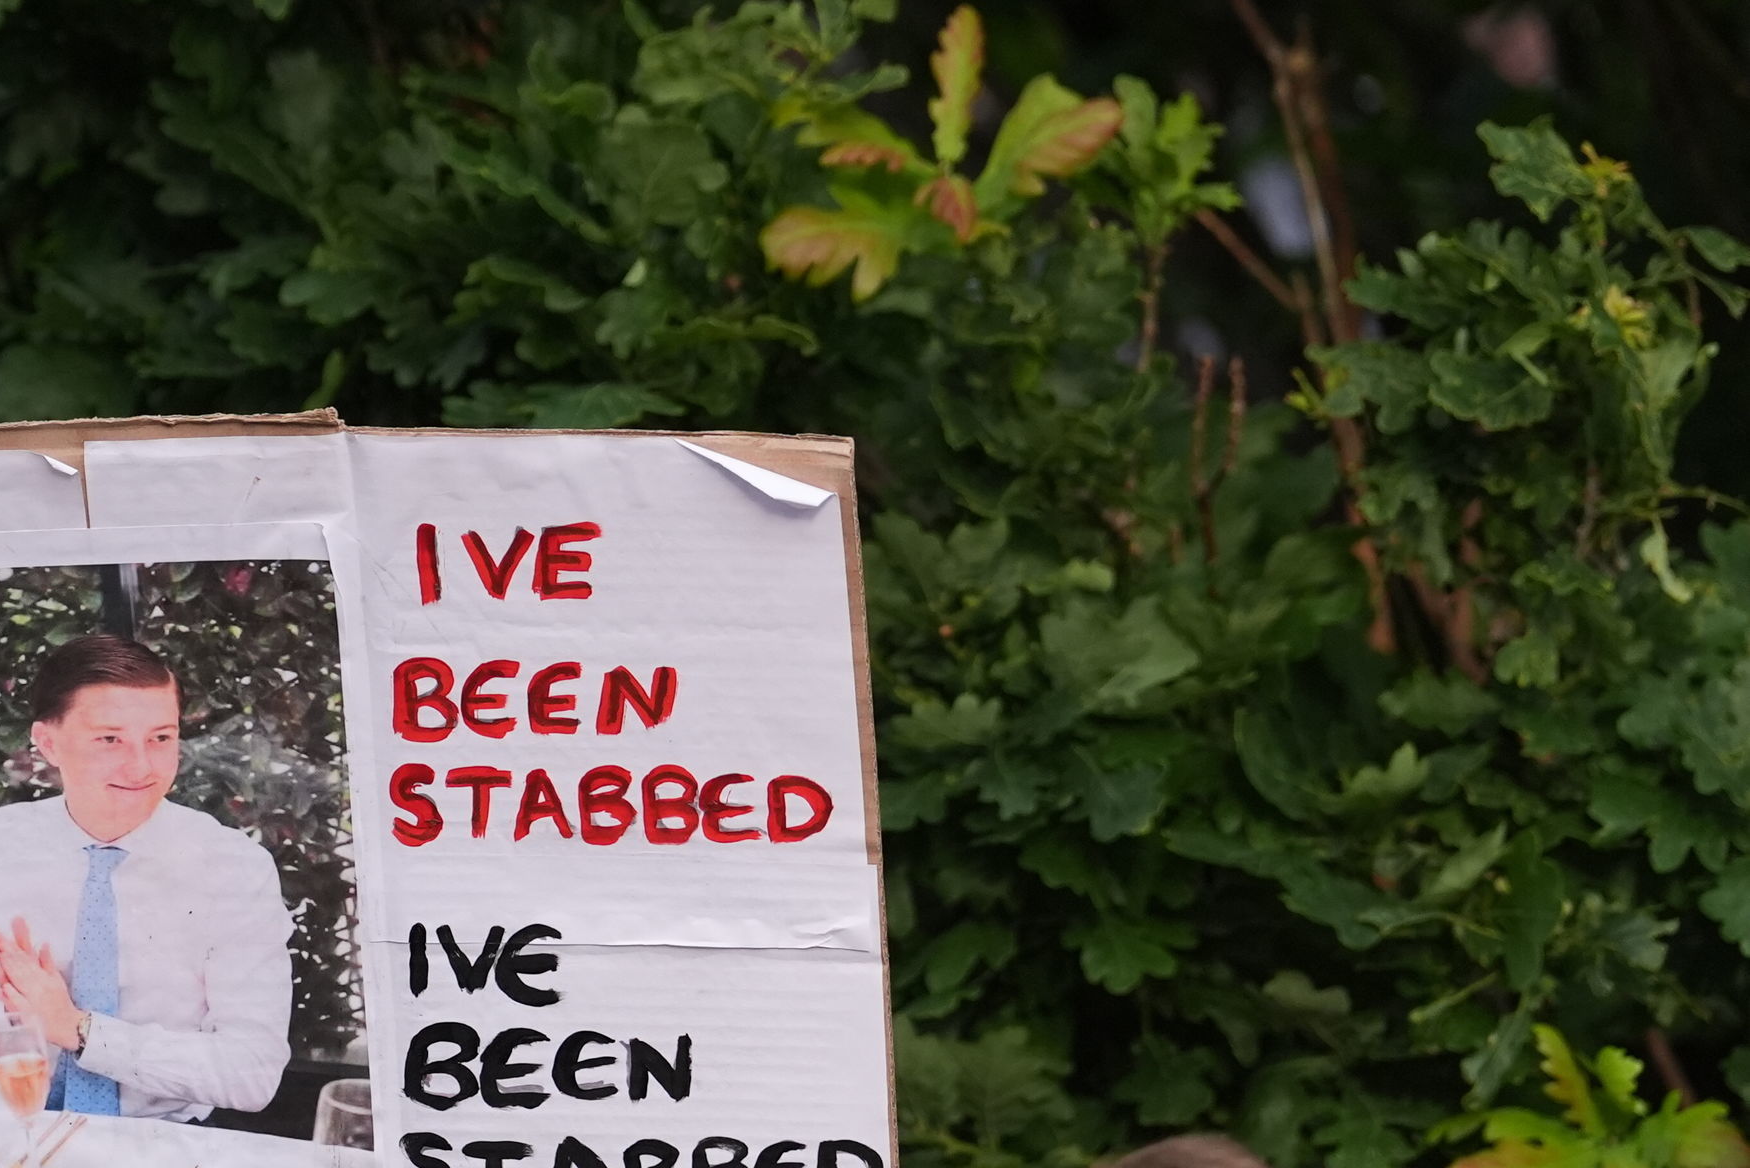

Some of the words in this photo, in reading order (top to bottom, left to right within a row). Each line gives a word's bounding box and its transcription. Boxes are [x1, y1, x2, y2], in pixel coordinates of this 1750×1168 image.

[416, 521, 603, 606] IVE
[392, 656, 677, 743] BEEN
[389, 762, 834, 848] STABBED
[408, 921, 566, 1008] IVE
[400, 1021, 693, 1111] BEEN
